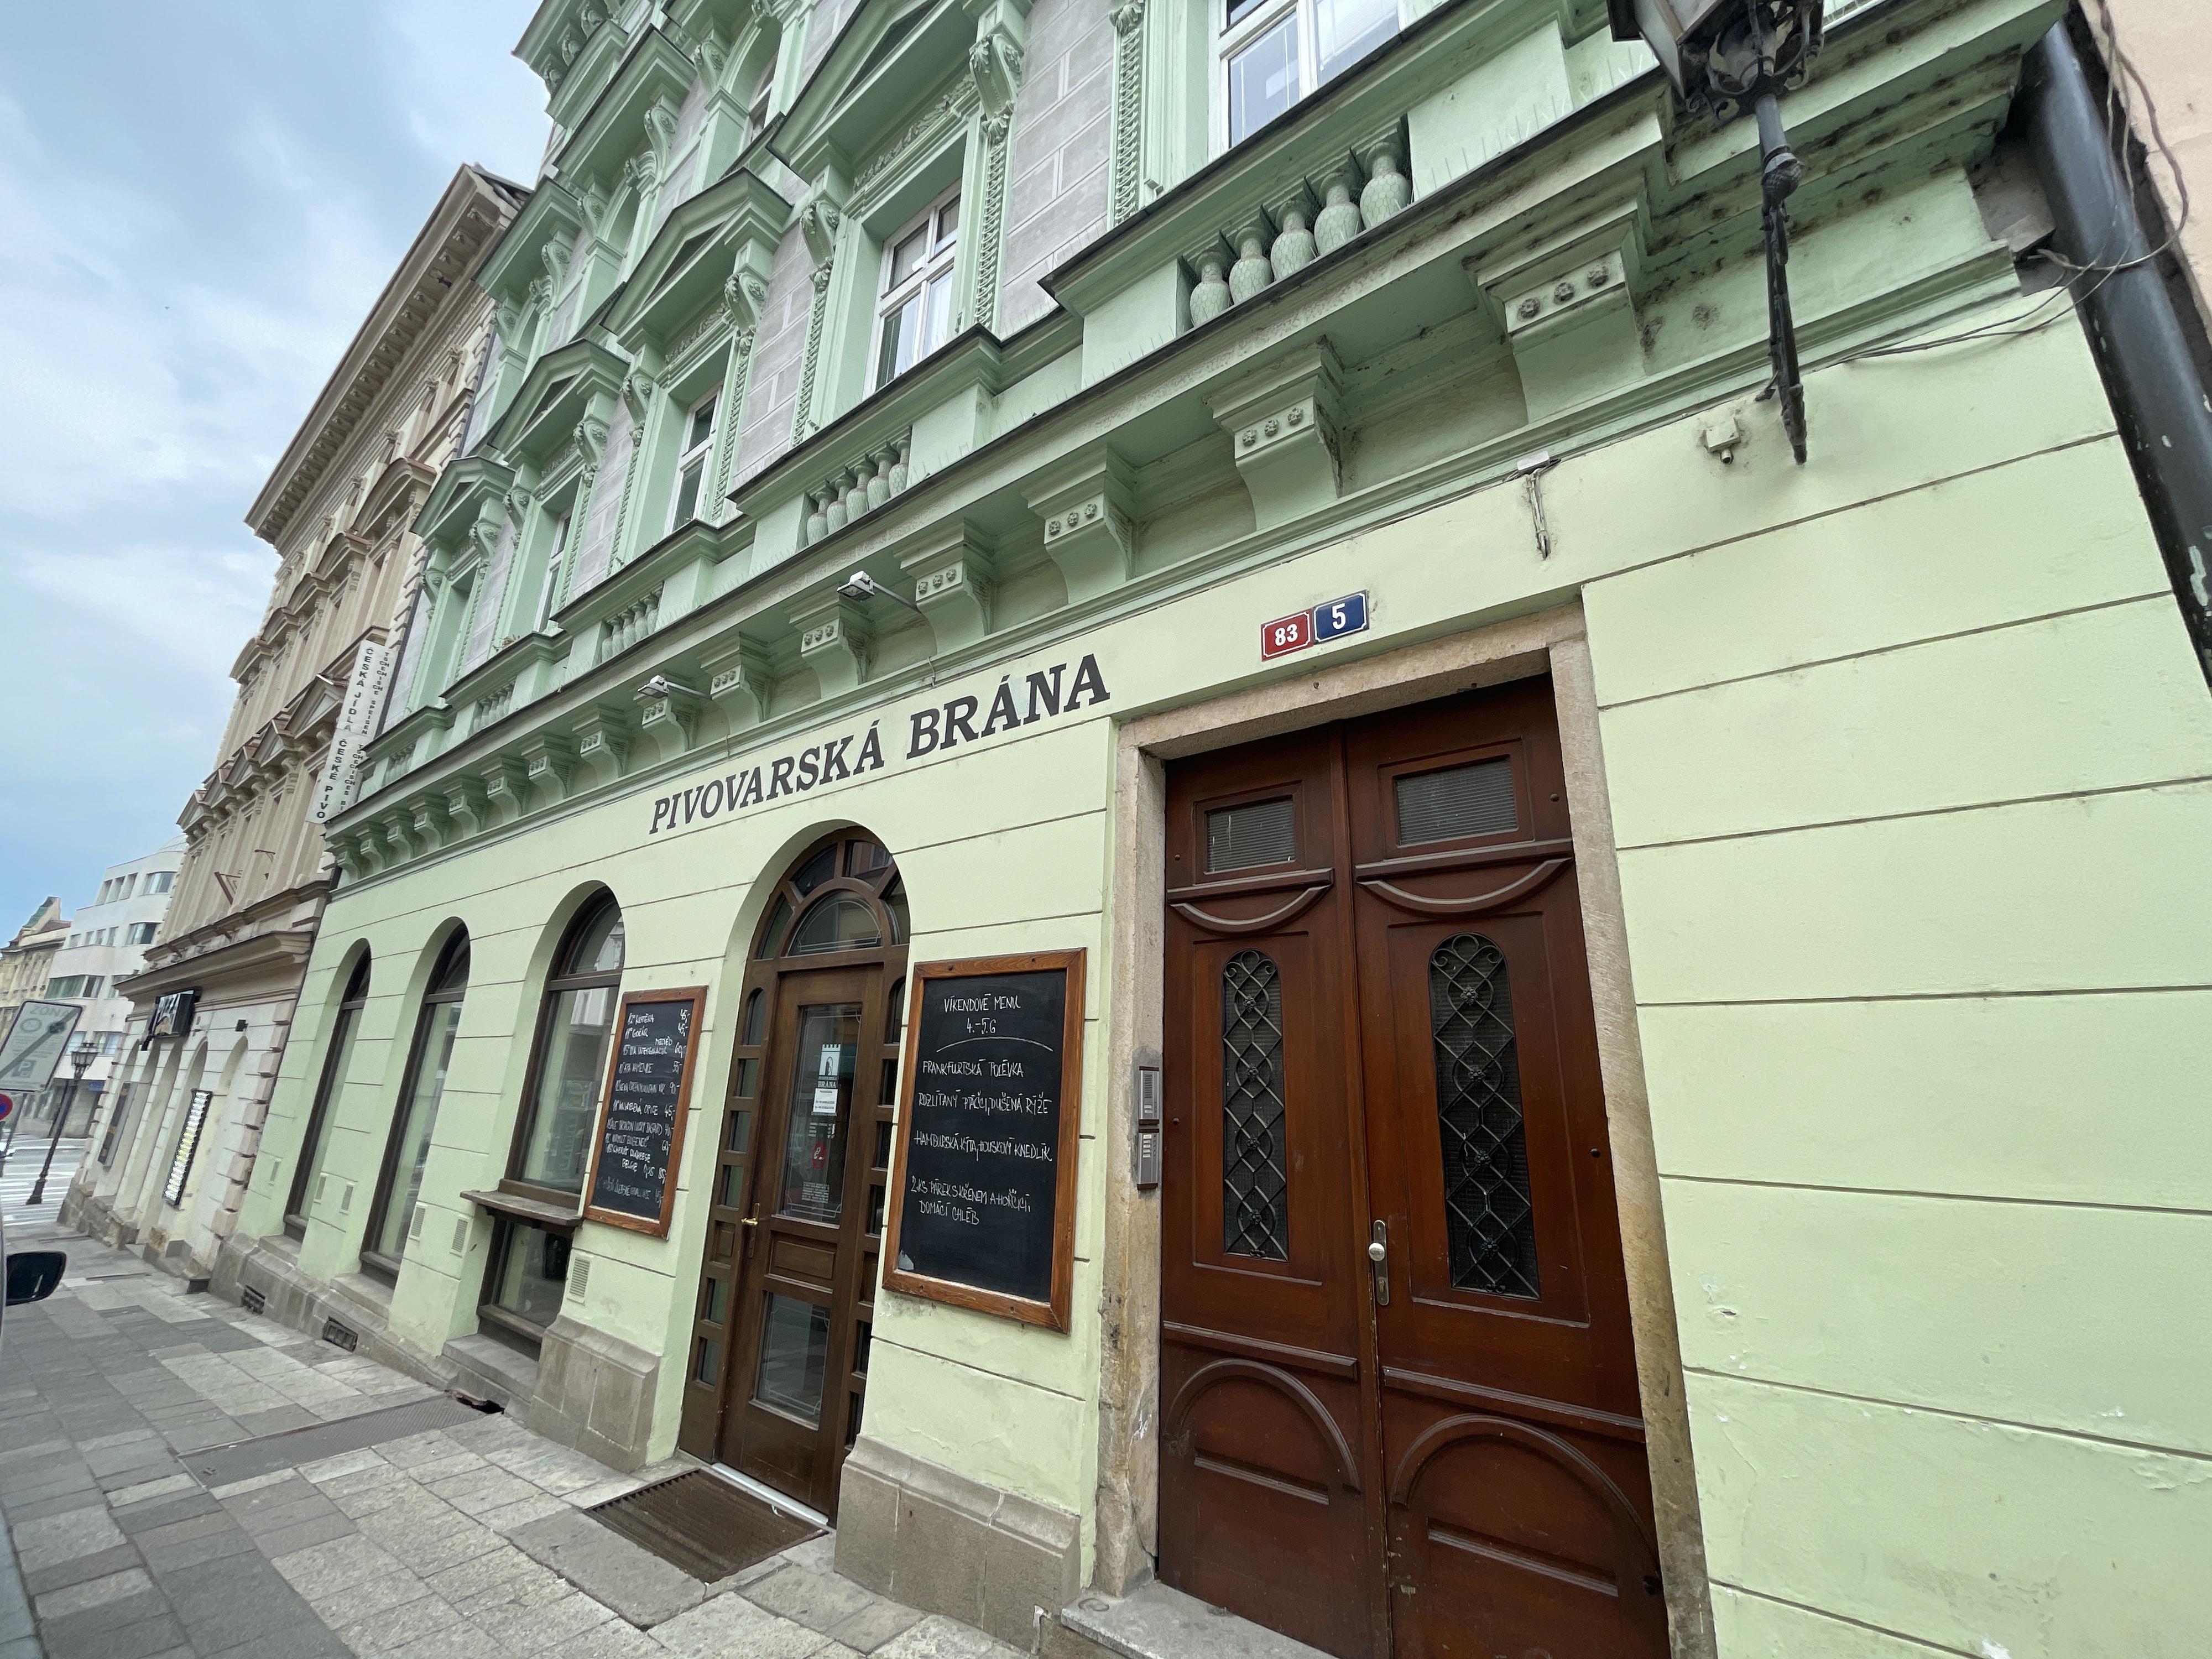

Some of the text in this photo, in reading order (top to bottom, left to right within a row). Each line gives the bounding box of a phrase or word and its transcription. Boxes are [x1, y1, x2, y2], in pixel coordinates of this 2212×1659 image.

[1332, 603, 1346, 629] 5
[1275, 624, 1298, 646] 83
[344, 647, 374, 732] ČESKÁ JÍDLA
[649, 653, 1110, 835] PIVOVARSKÁ BRÁNA
[316, 738, 347, 818] ČESKÉ PIVO
[944, 993, 1021, 1013] VÍKENDOVÉ MENU
[922, 1059, 1024, 1077] FRANKFURTSKÁ POLÉVKA
[1025, 1091, 1052, 1115] RÝŽE
[1014, 1142, 1052, 1161] KNEDLÍK
[929, 1178, 951, 1197] PÁREK
[958, 1183, 988, 1205] KŘENEM
[919, 1201, 979, 1225] DOMÁCÍ CHLÉB
